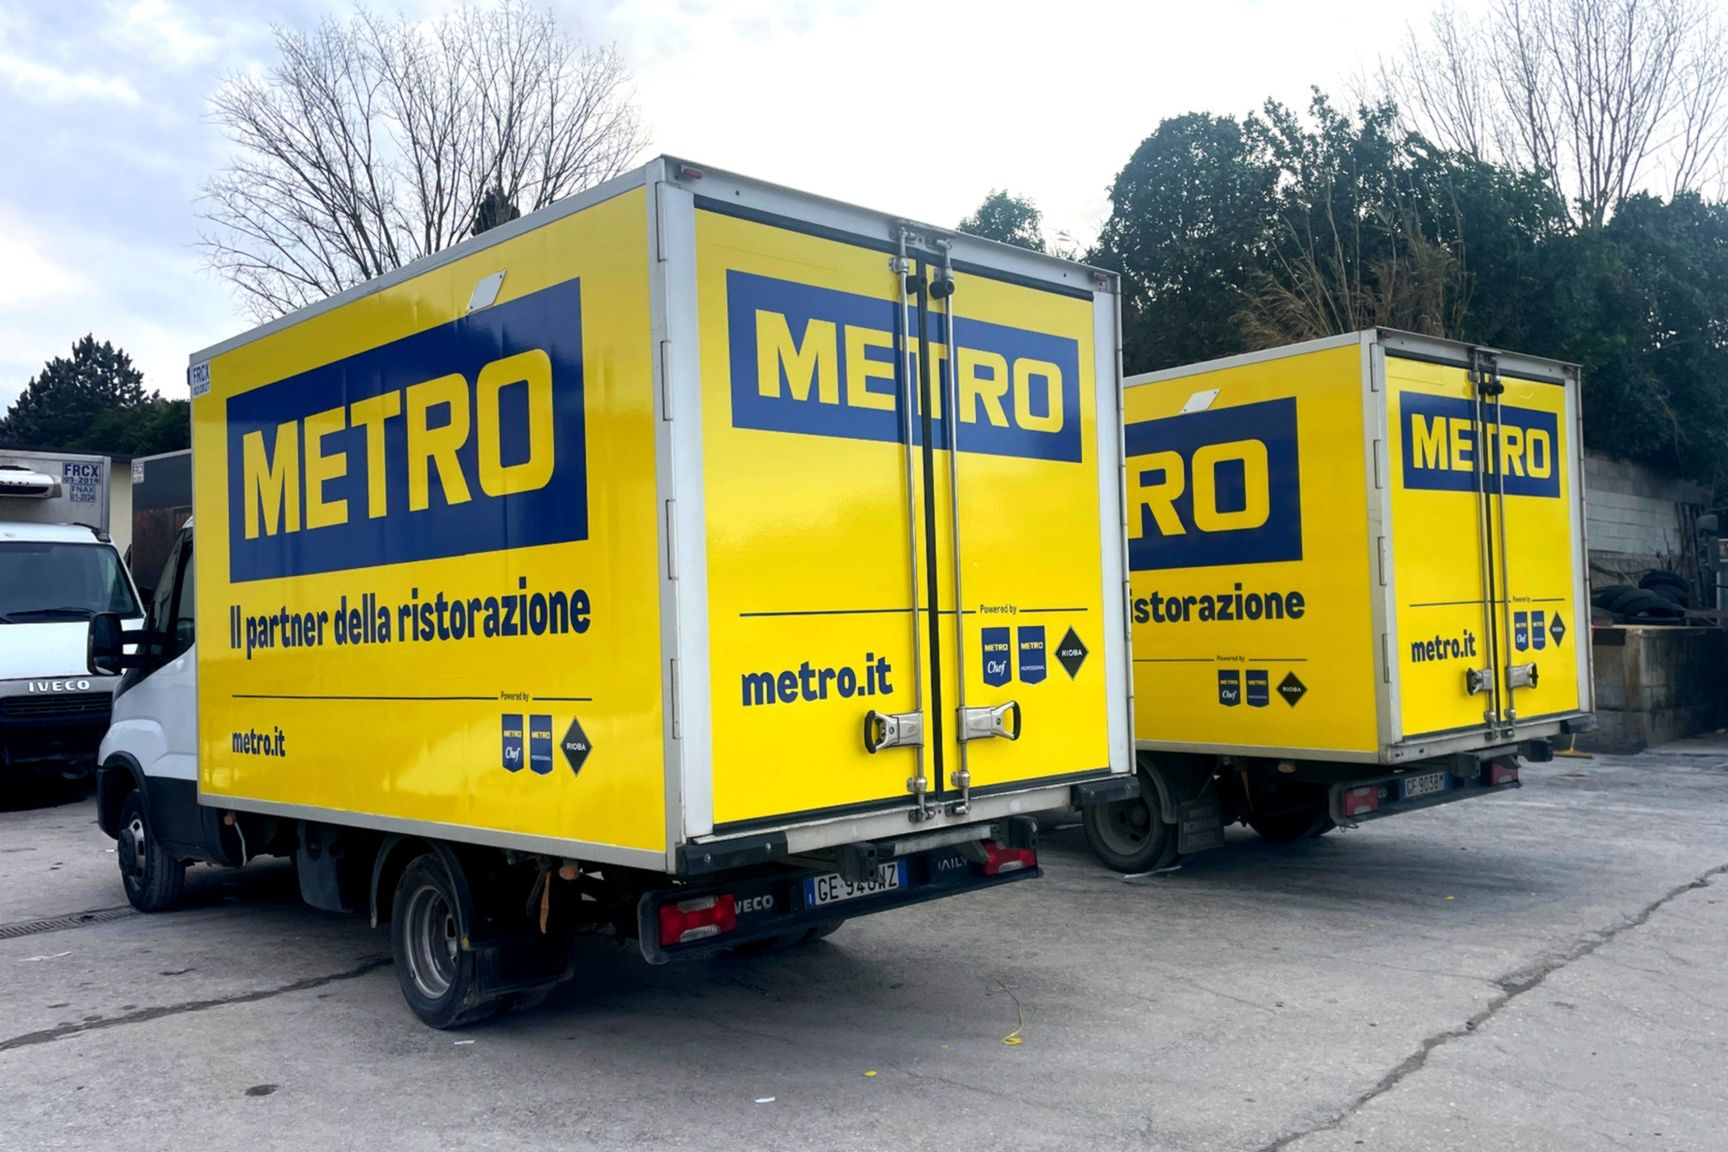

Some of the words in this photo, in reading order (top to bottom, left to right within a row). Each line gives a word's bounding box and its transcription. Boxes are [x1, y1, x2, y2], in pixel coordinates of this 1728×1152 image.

[755, 308, 1064, 434] METRO
[242, 348, 555, 540] METRO
[1411, 413, 1551, 479] METRO
[64, 464, 98, 477] FRCX
[980, 604, 1007, 613] Powered
[1009, 604, 1016, 614] by
[230, 605, 242, 649] Il
[246, 605, 328, 660] partner
[334, 592, 391, 645] della
[399, 577, 591, 642] ristorazione
[984, 643, 1008, 651] METRO
[1021, 642, 1043, 650] METRO
[1411, 630, 1476, 662] metro.it
[987, 660, 1007, 676] Chef
[28, 680, 90, 692] IVECO
[742, 653, 893, 706] metro.it
[501, 691, 521, 700] Powered
[232, 726, 286, 757] metro.it
[531, 731, 551, 739] METRO
[505, 746, 521, 762] Chef
[566, 742, 586, 751] RIOBA
[818, 875, 838, 902] GE
[734, 894, 774, 914] VECO
